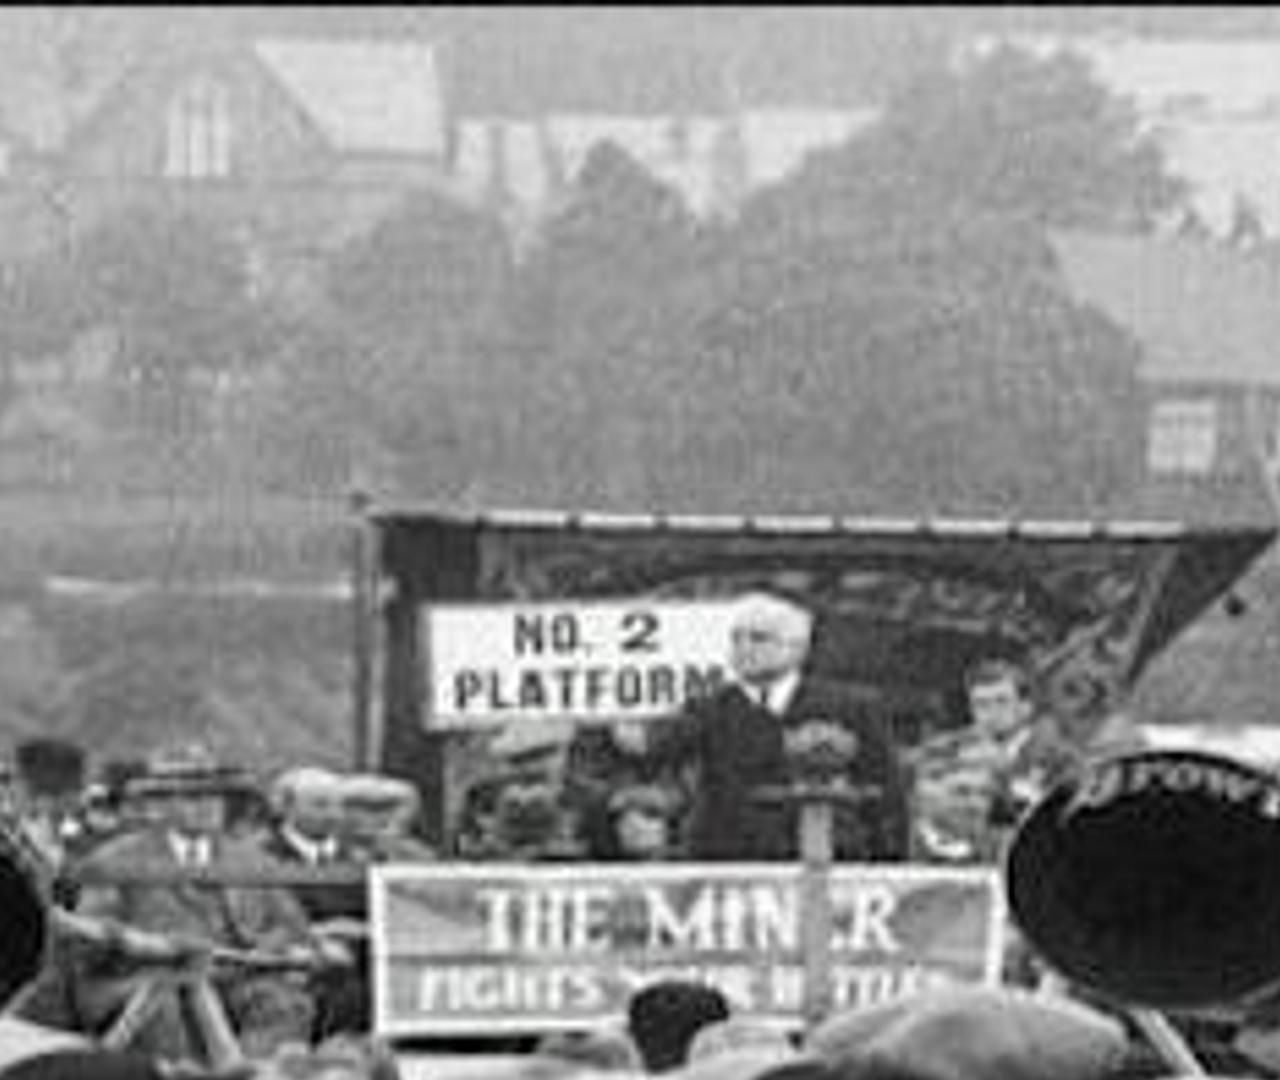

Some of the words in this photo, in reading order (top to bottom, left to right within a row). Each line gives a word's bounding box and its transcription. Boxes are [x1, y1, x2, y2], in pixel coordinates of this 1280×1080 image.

[622, 613, 658, 652] 2
[453, 663, 728, 710] PLATFORM
[477, 887, 612, 952] THE
[645, 884, 902, 952] MINR
